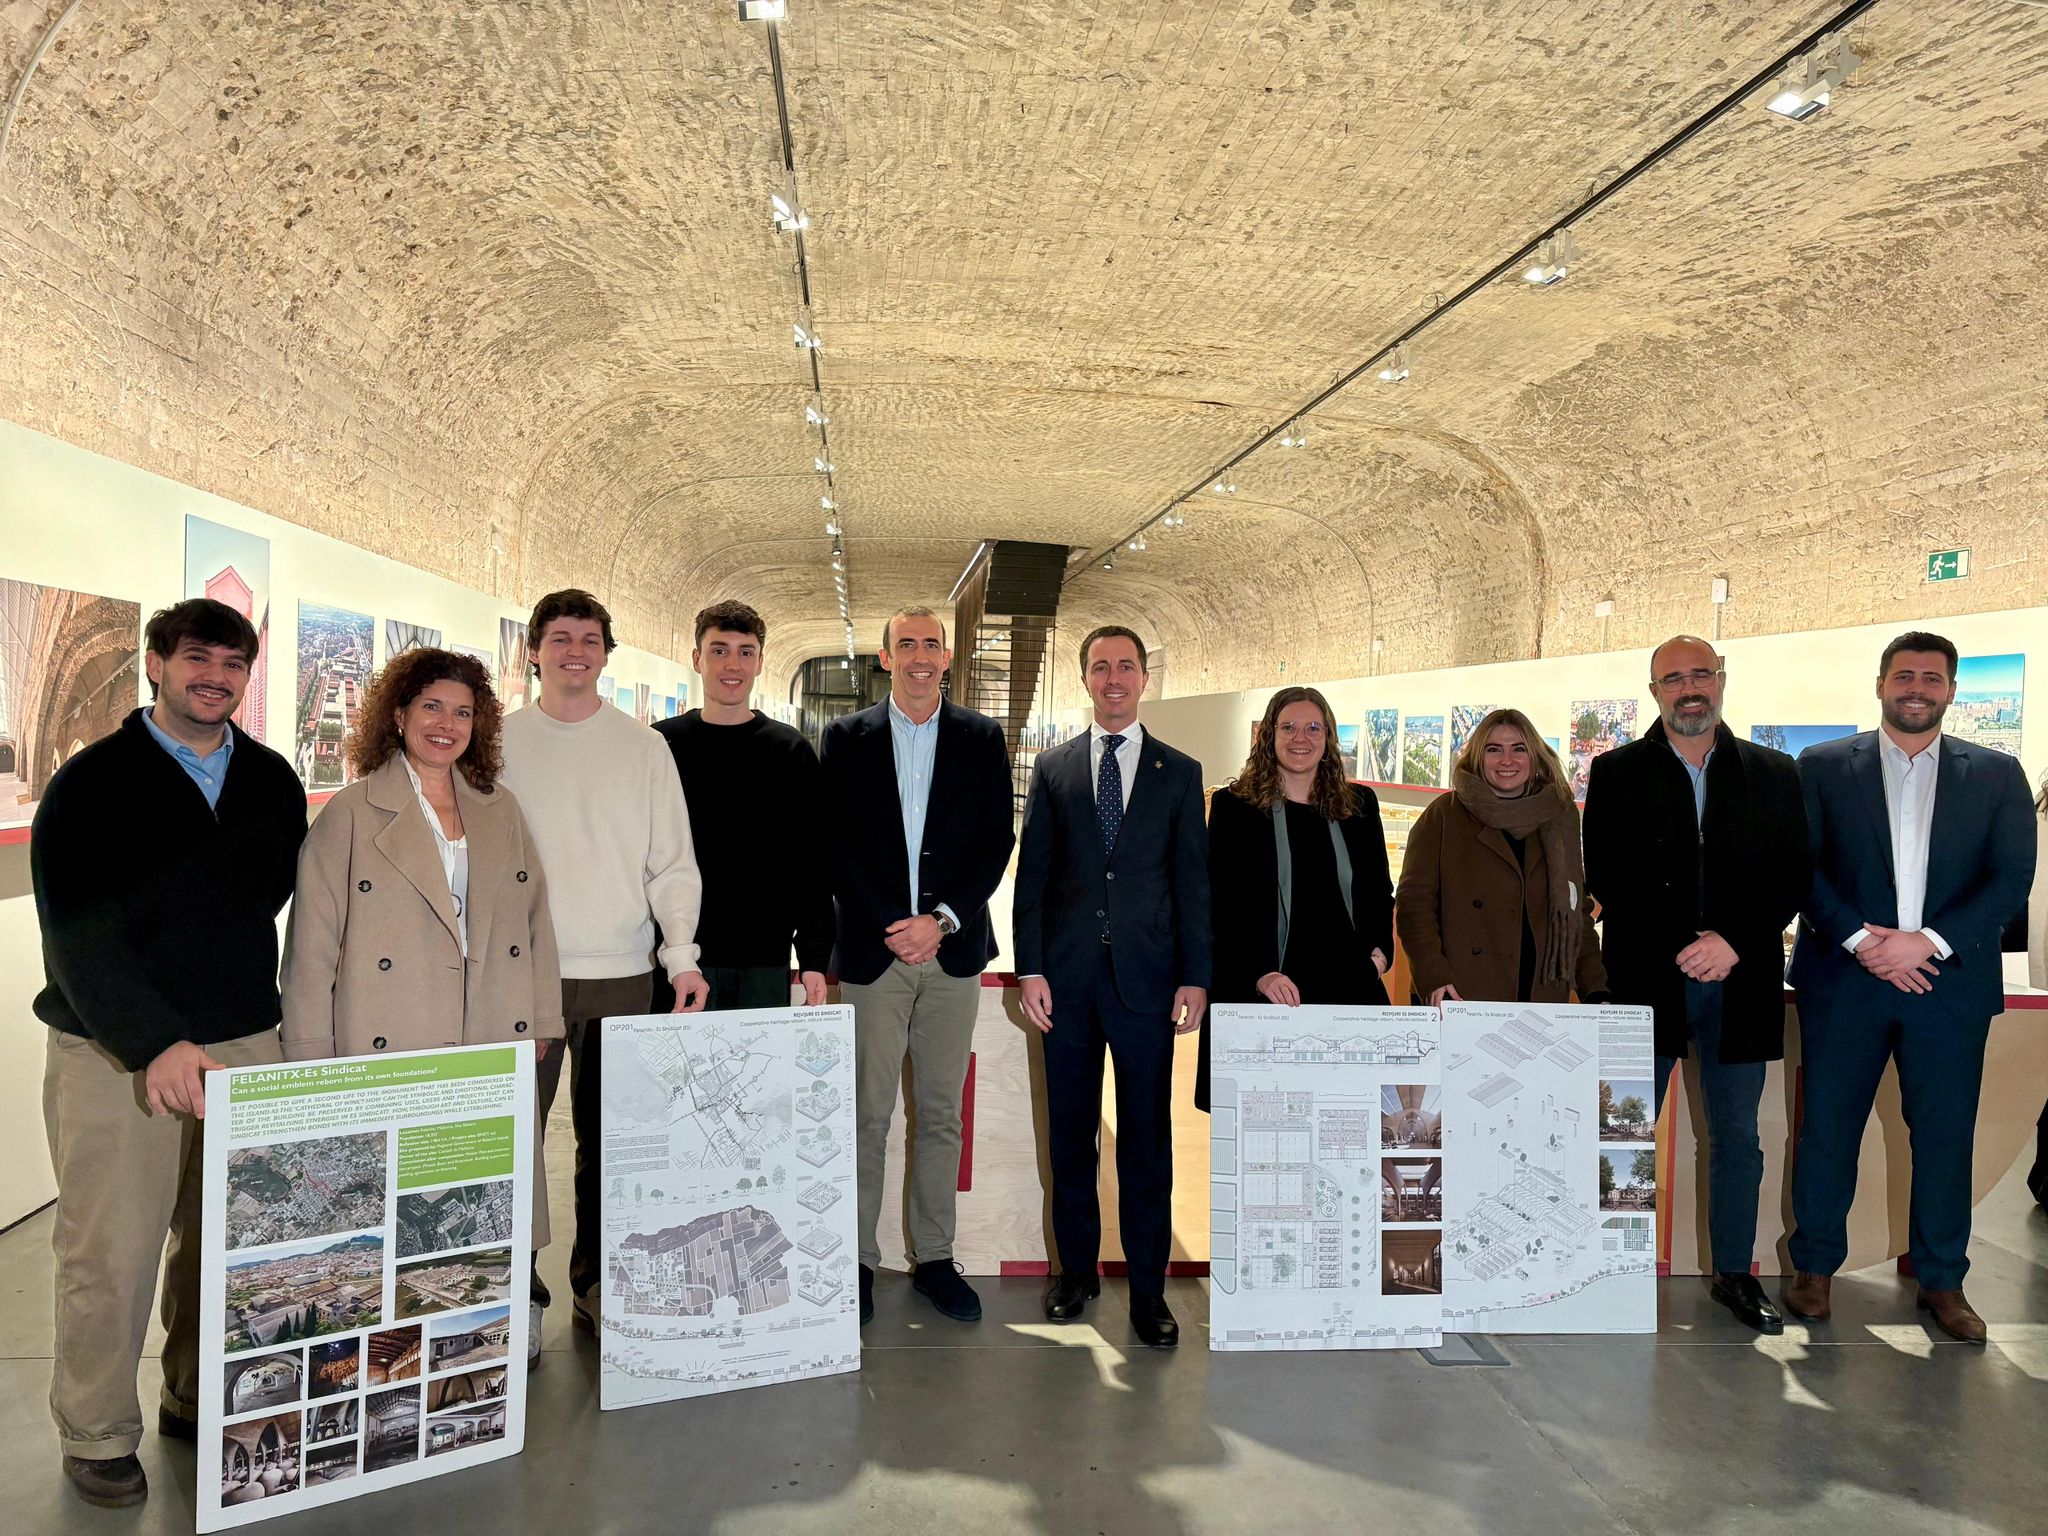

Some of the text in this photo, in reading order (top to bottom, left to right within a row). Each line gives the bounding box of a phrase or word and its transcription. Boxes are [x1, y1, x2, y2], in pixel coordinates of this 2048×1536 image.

[1431, 1013, 1437, 1022] 2
[1645, 1012, 1650, 1020] 3
[232, 1063, 366, 1084] FELANITX-Es Sindicat
[281, 1080, 313, 1089] emblem
[316, 1077, 342, 1085] reborn
[393, 1067, 436, 1077] foundations?
[248, 1101, 277, 1109] POSSIBLE
[273, 1112, 304, 1120] BUILDING
[318, 1107, 352, 1115] PRESERVED
[365, 1101, 402, 1109] COMBINING
[230, 1130, 260, 1139] SINDICAT
[262, 1125, 305, 1135] STRENGTHEN
[360, 1115, 393, 1123] IMMEDIATE
[395, 1109, 442, 1119] SURROUNDINGS
[231, 1124, 259, 1132] TRIGGER
[261, 1119, 303, 1129] REVITALISING
[305, 1115, 339, 1123] SYNERGIES
